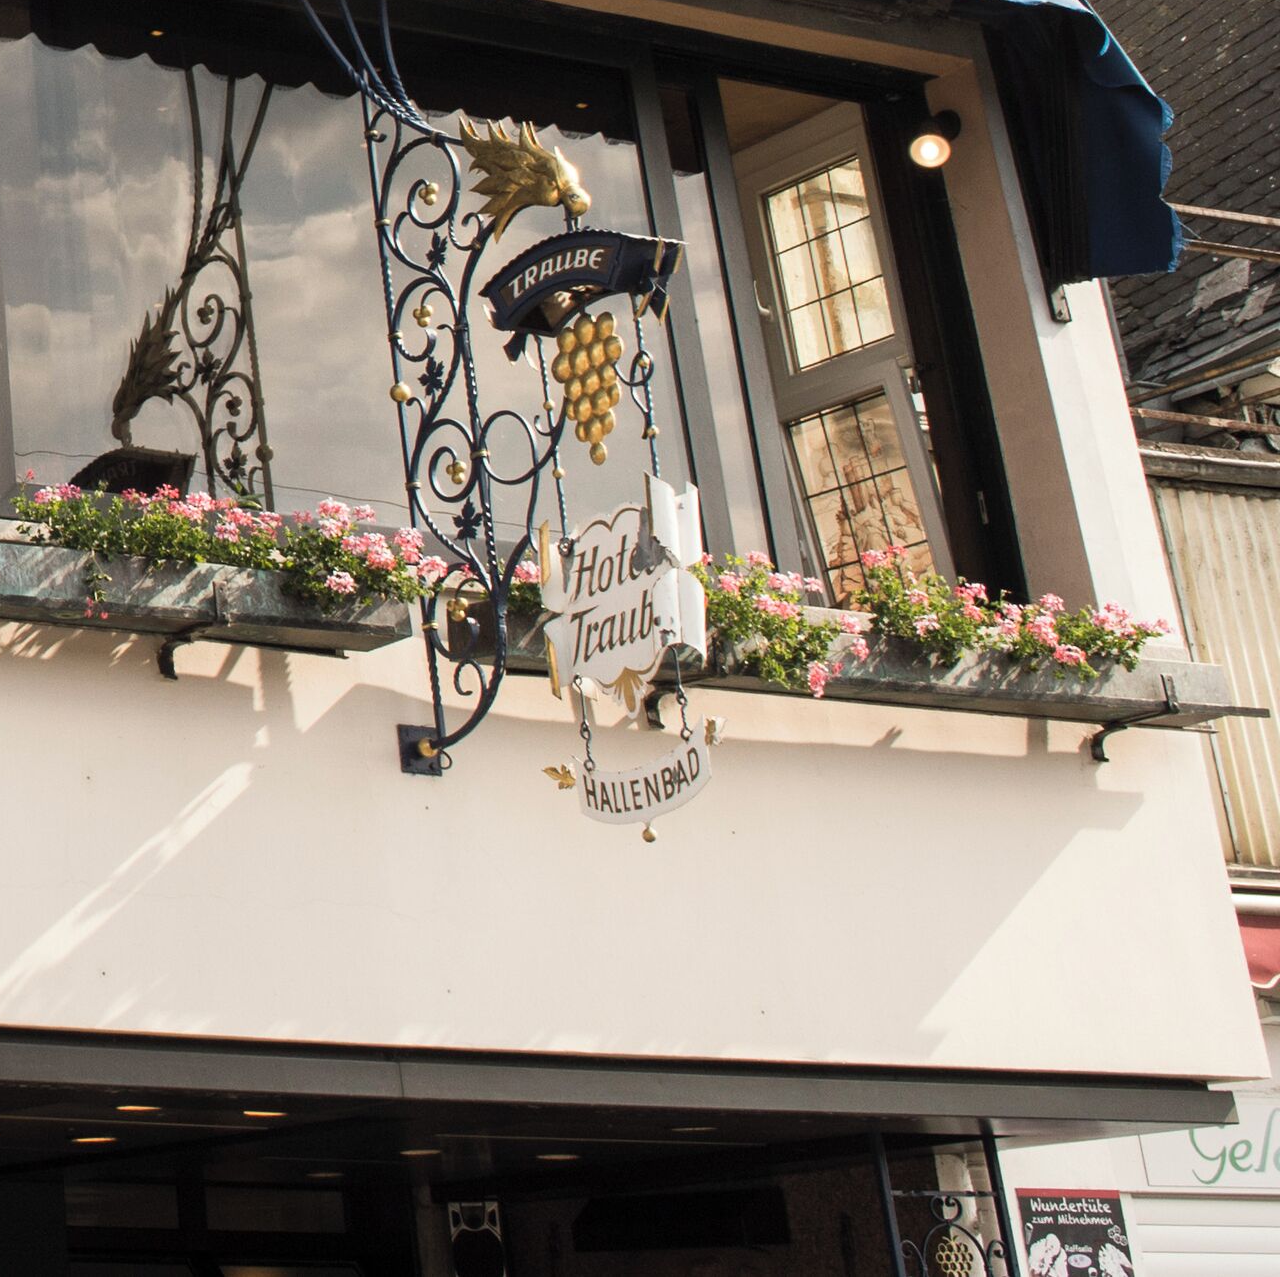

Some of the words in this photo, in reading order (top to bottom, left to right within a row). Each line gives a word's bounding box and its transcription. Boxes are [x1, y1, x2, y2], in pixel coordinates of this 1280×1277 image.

[508, 248, 605, 299] TRAUBE
[570, 590, 657, 667] Traub
[582, 746, 700, 814] HALLENBAD
[1188, 1107, 1280, 1185] Gel
[1030, 1196, 1112, 1213] Wundertüte
[1031, 1215, 1054, 1224] zum
[1057, 1213, 1114, 1225] Mitnehmen
